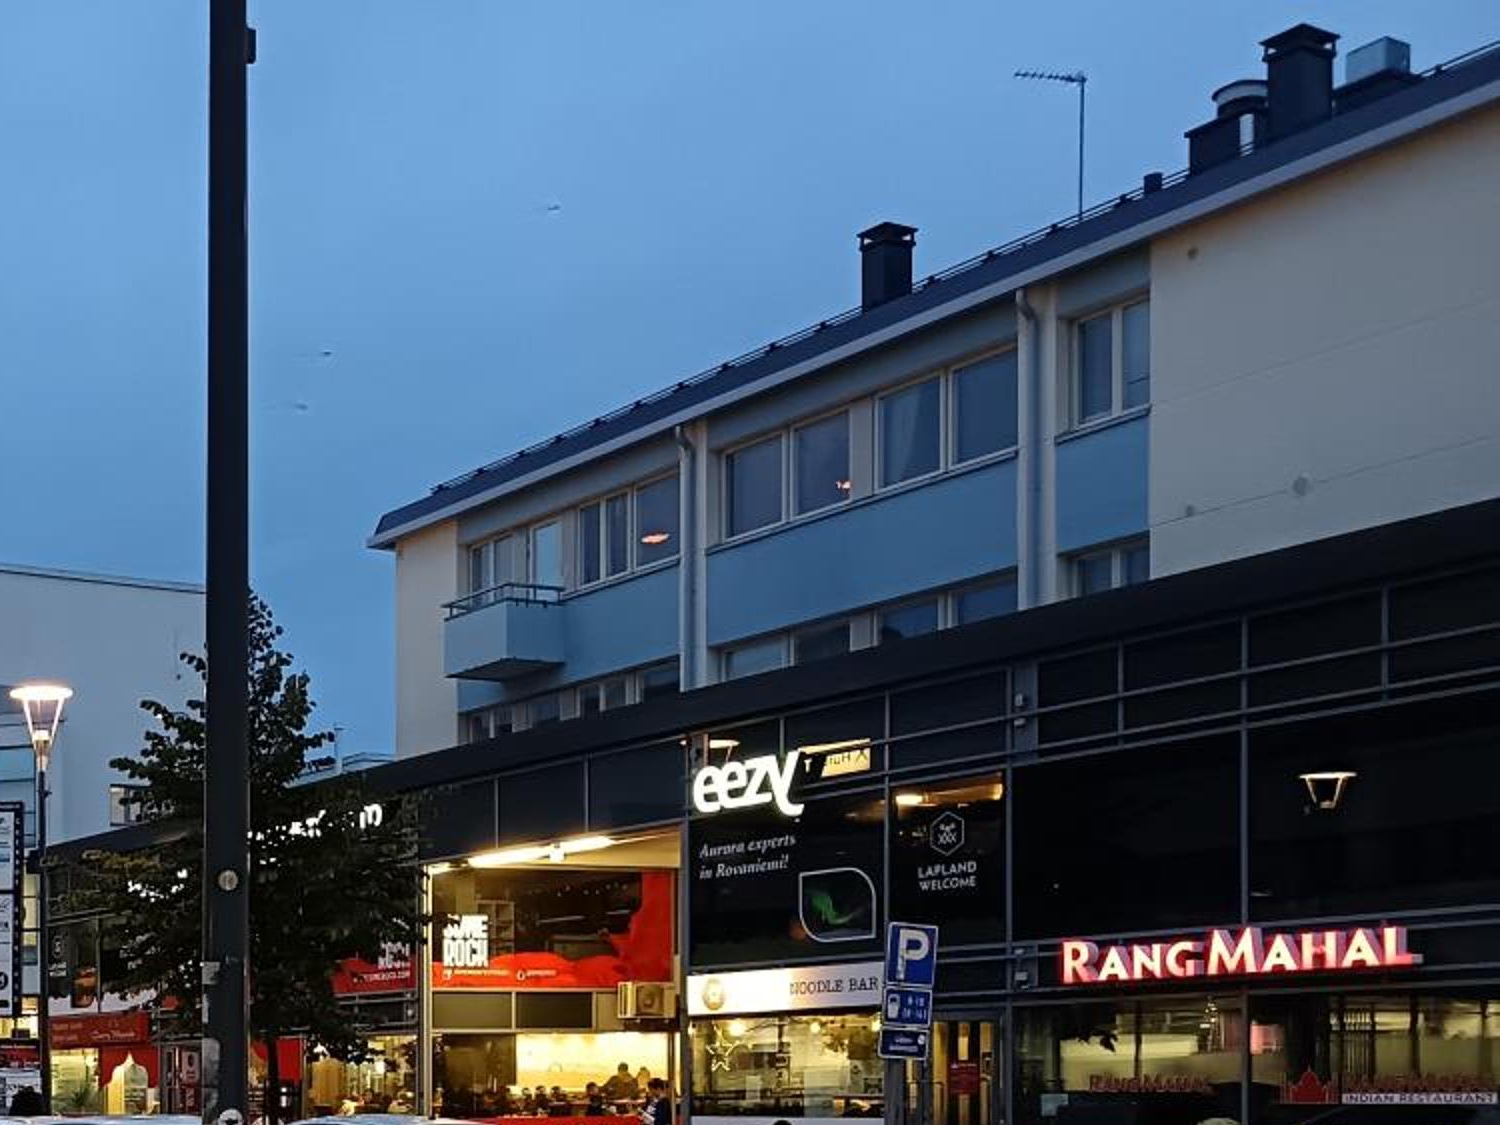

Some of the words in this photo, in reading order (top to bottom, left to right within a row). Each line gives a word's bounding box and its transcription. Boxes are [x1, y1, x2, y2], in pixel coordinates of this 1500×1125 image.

[693, 748, 805, 816] eezy
[700, 841, 746, 859] Aurora
[747, 834, 797, 854] experts
[700, 865, 714, 880] in
[716, 854, 790, 879] Rovaniemi!
[917, 861, 978, 879] LAPLAND
[918, 876, 977, 891] WELCOME
[897, 928, 929, 980] P
[1062, 940, 1201, 984] RANG
[1206, 926, 1421, 977] MAHAL
[847, 977, 879, 993] BAR
[1346, 1092, 1396, 1104] INDIAN
[1399, 1092, 1495, 1104] RESTAURANT
